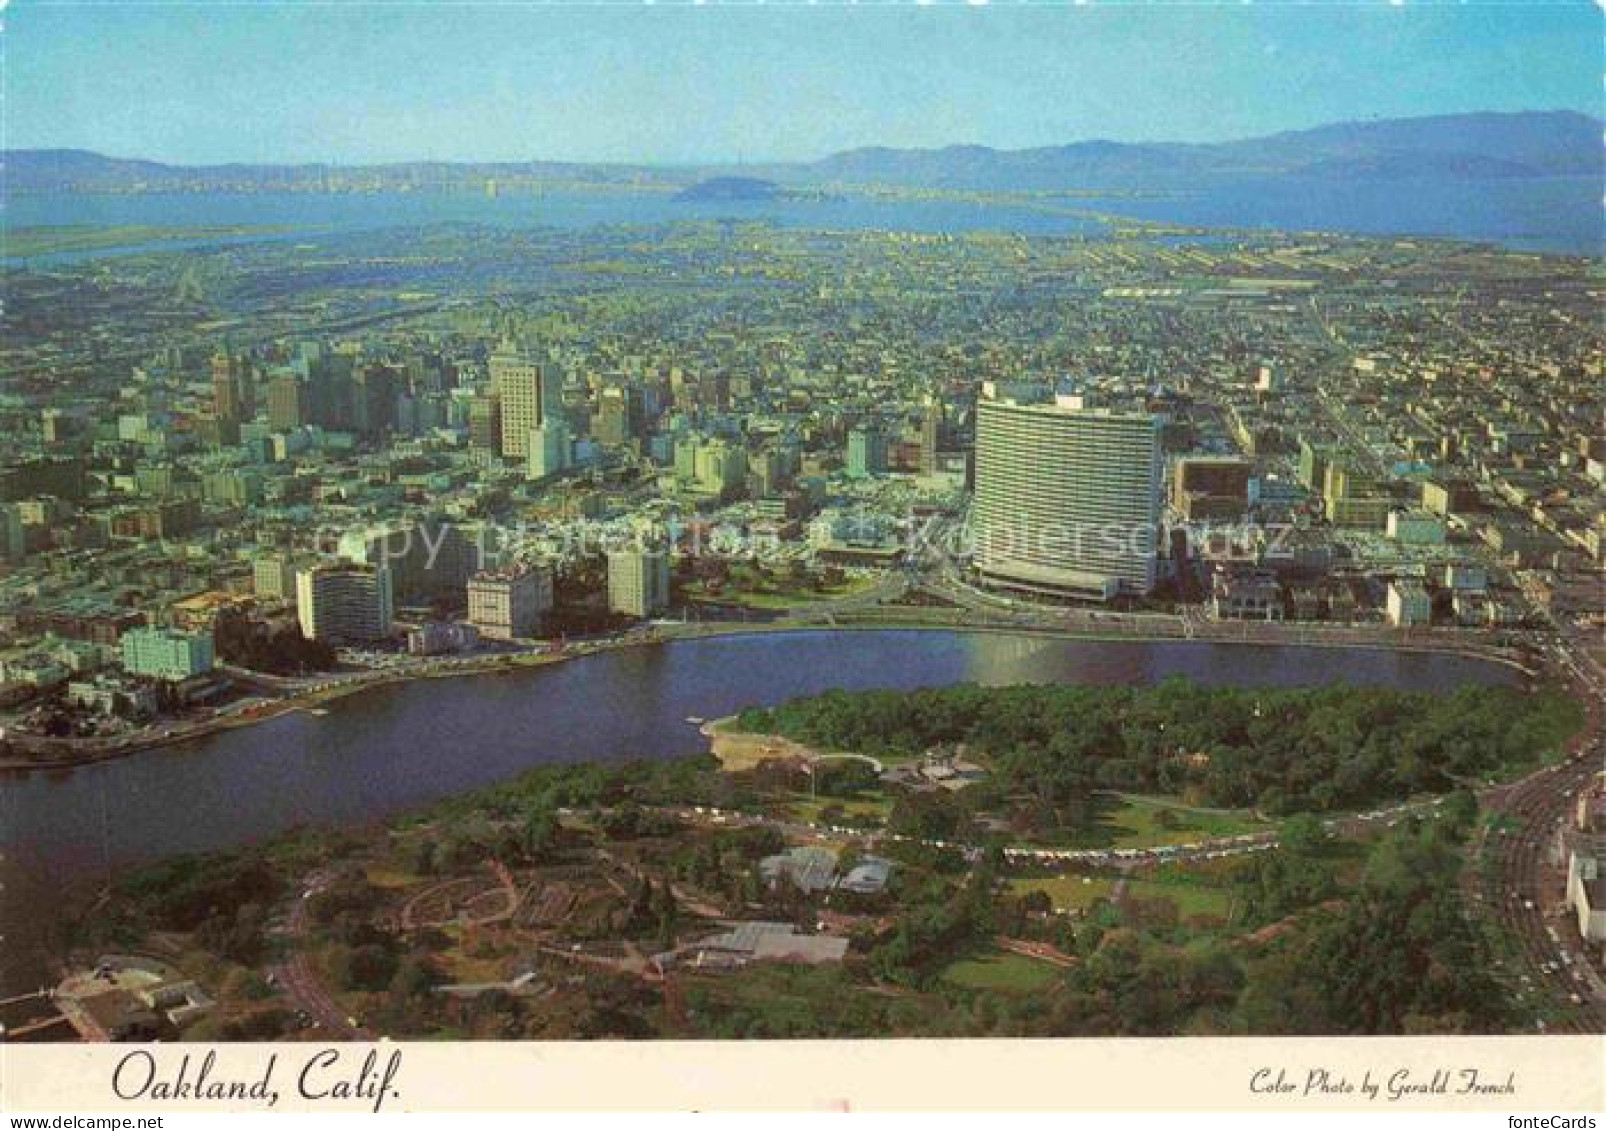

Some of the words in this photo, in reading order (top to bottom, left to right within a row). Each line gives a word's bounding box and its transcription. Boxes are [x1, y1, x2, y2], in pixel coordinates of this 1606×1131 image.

[112, 1049, 279, 1106] Oakland,
[297, 1048, 402, 1113] Calif.
[1249, 1067, 1297, 1094] Color
[1303, 1068, 1355, 1096] Photo
[1361, 1070, 1380, 1101] by
[1387, 1068, 1451, 1102] Gerald
[1455, 1068, 1515, 1095] French
